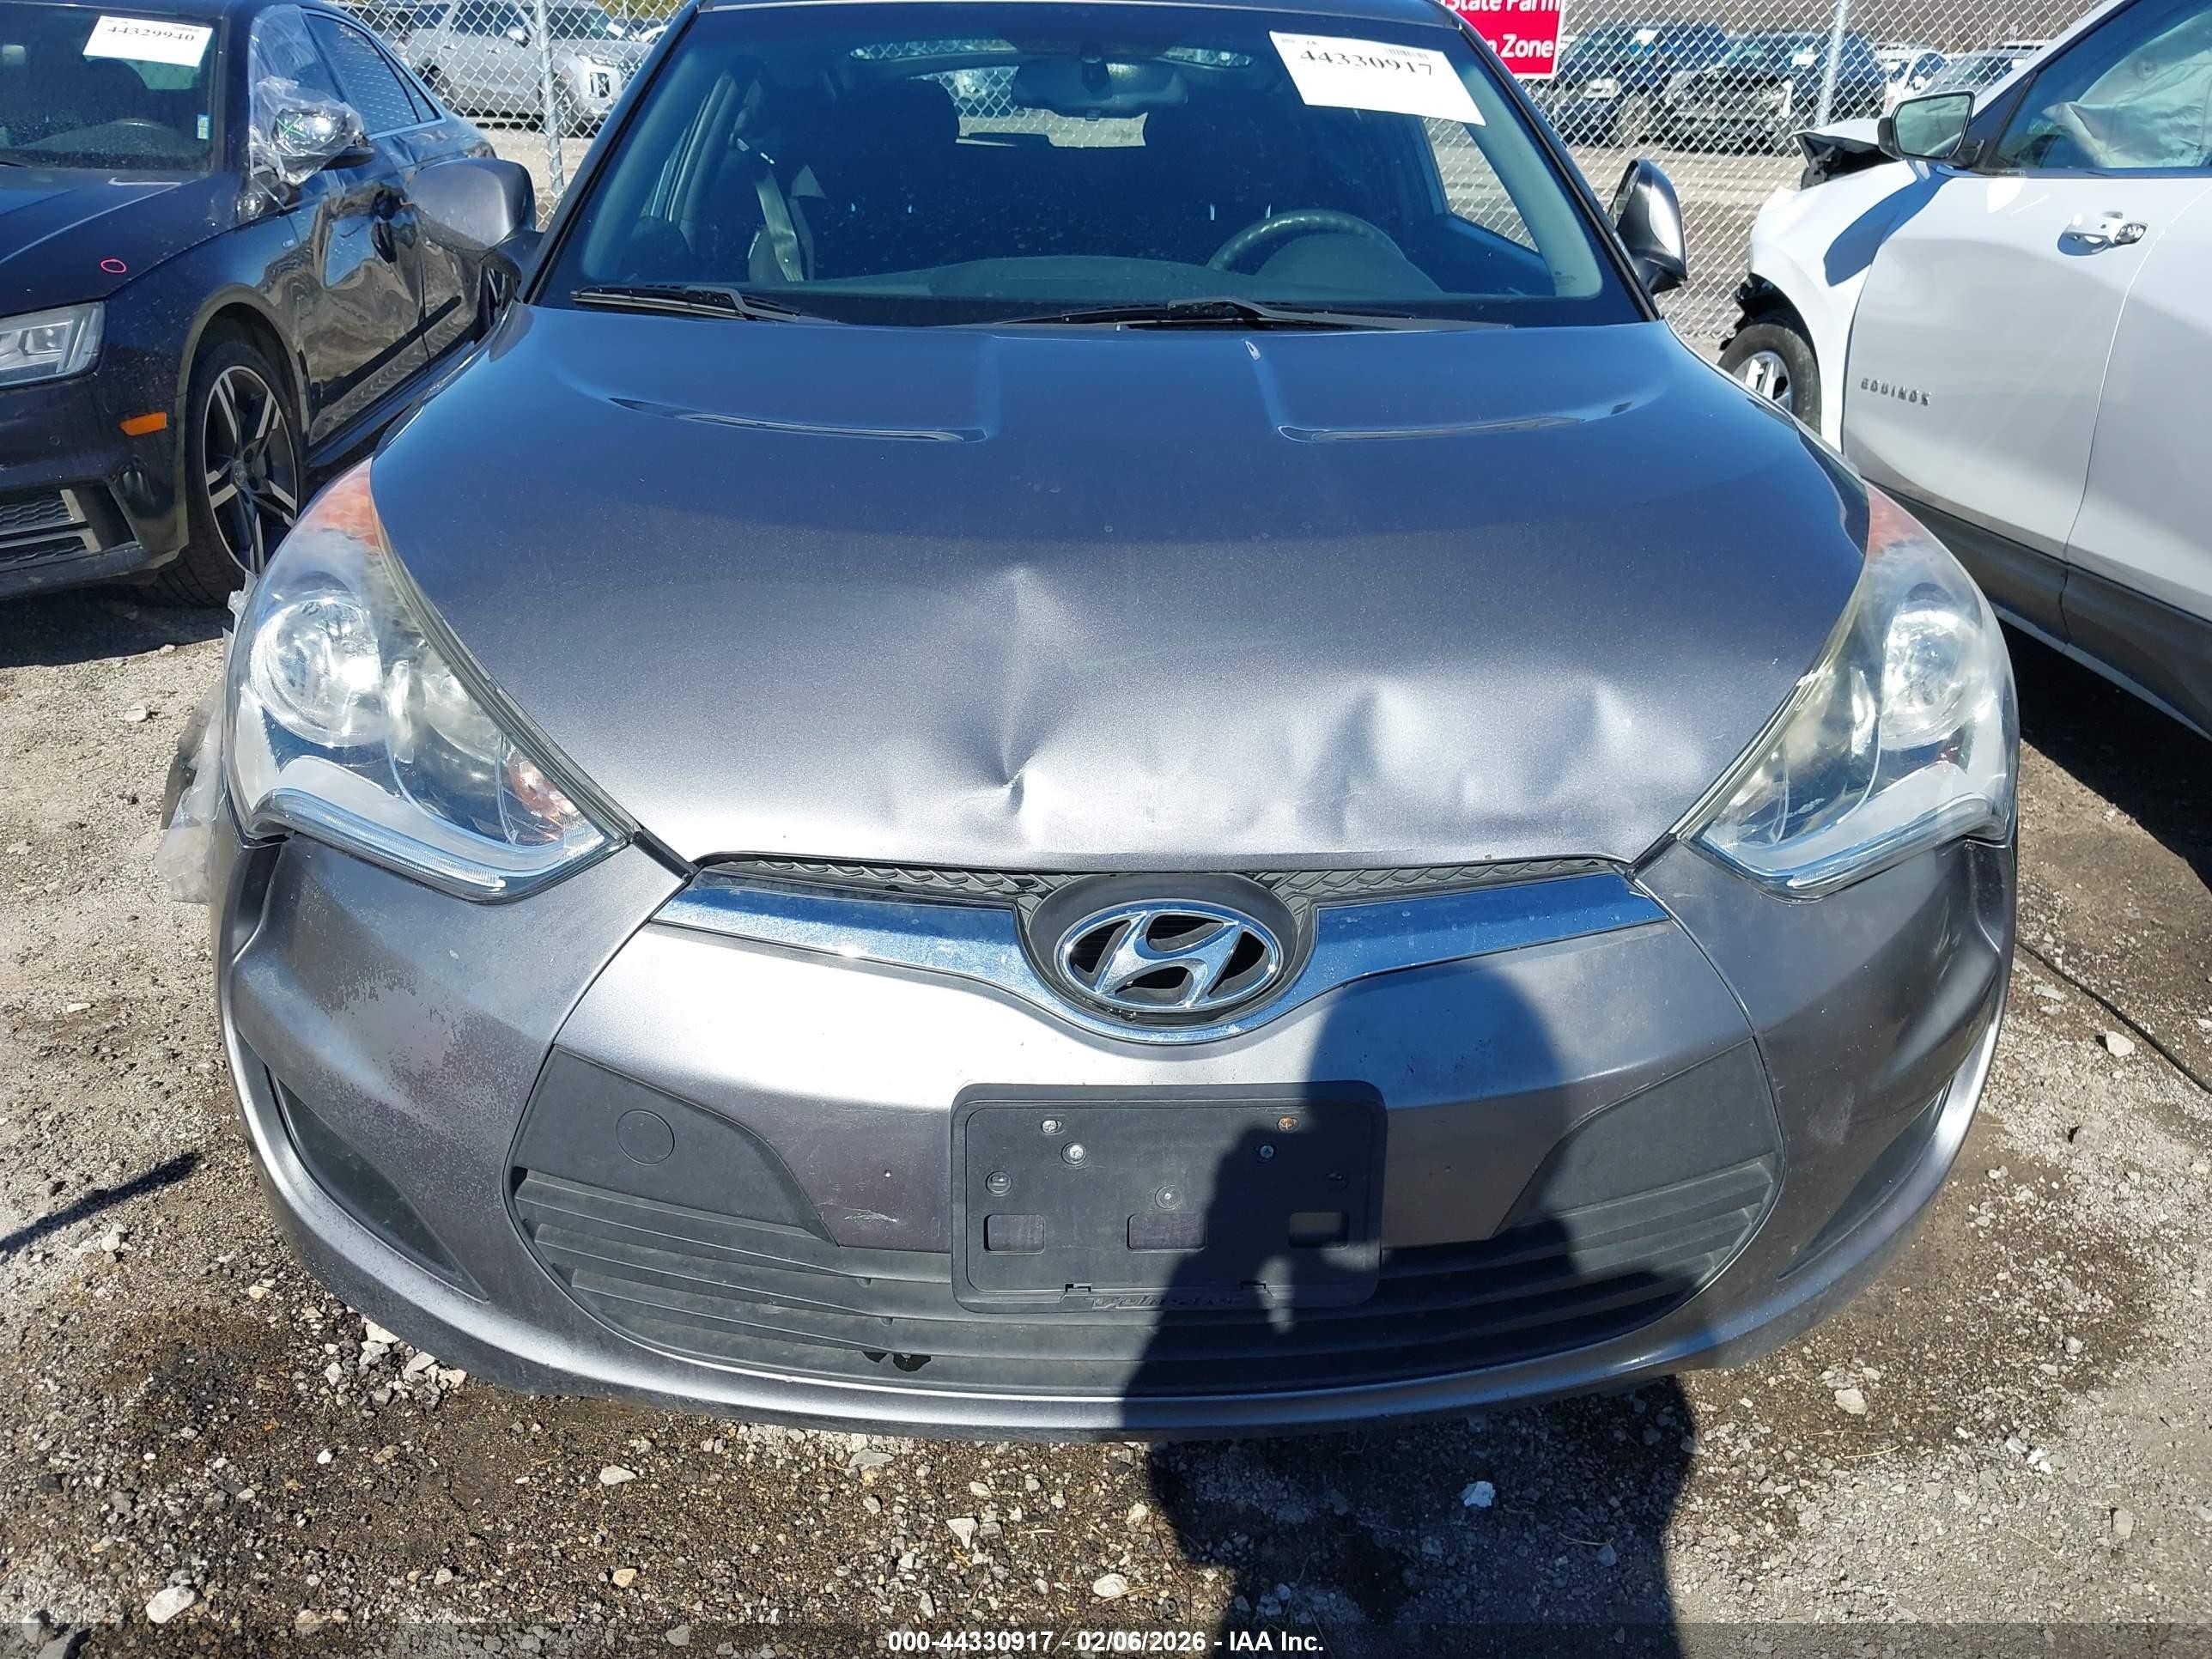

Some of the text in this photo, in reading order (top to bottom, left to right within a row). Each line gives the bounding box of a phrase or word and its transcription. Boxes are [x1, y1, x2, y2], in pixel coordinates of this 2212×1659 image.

[106, 26, 195, 42] 44329940
[1500, 33, 1554, 58] Zone
[1300, 50, 1432, 76] 44330917
